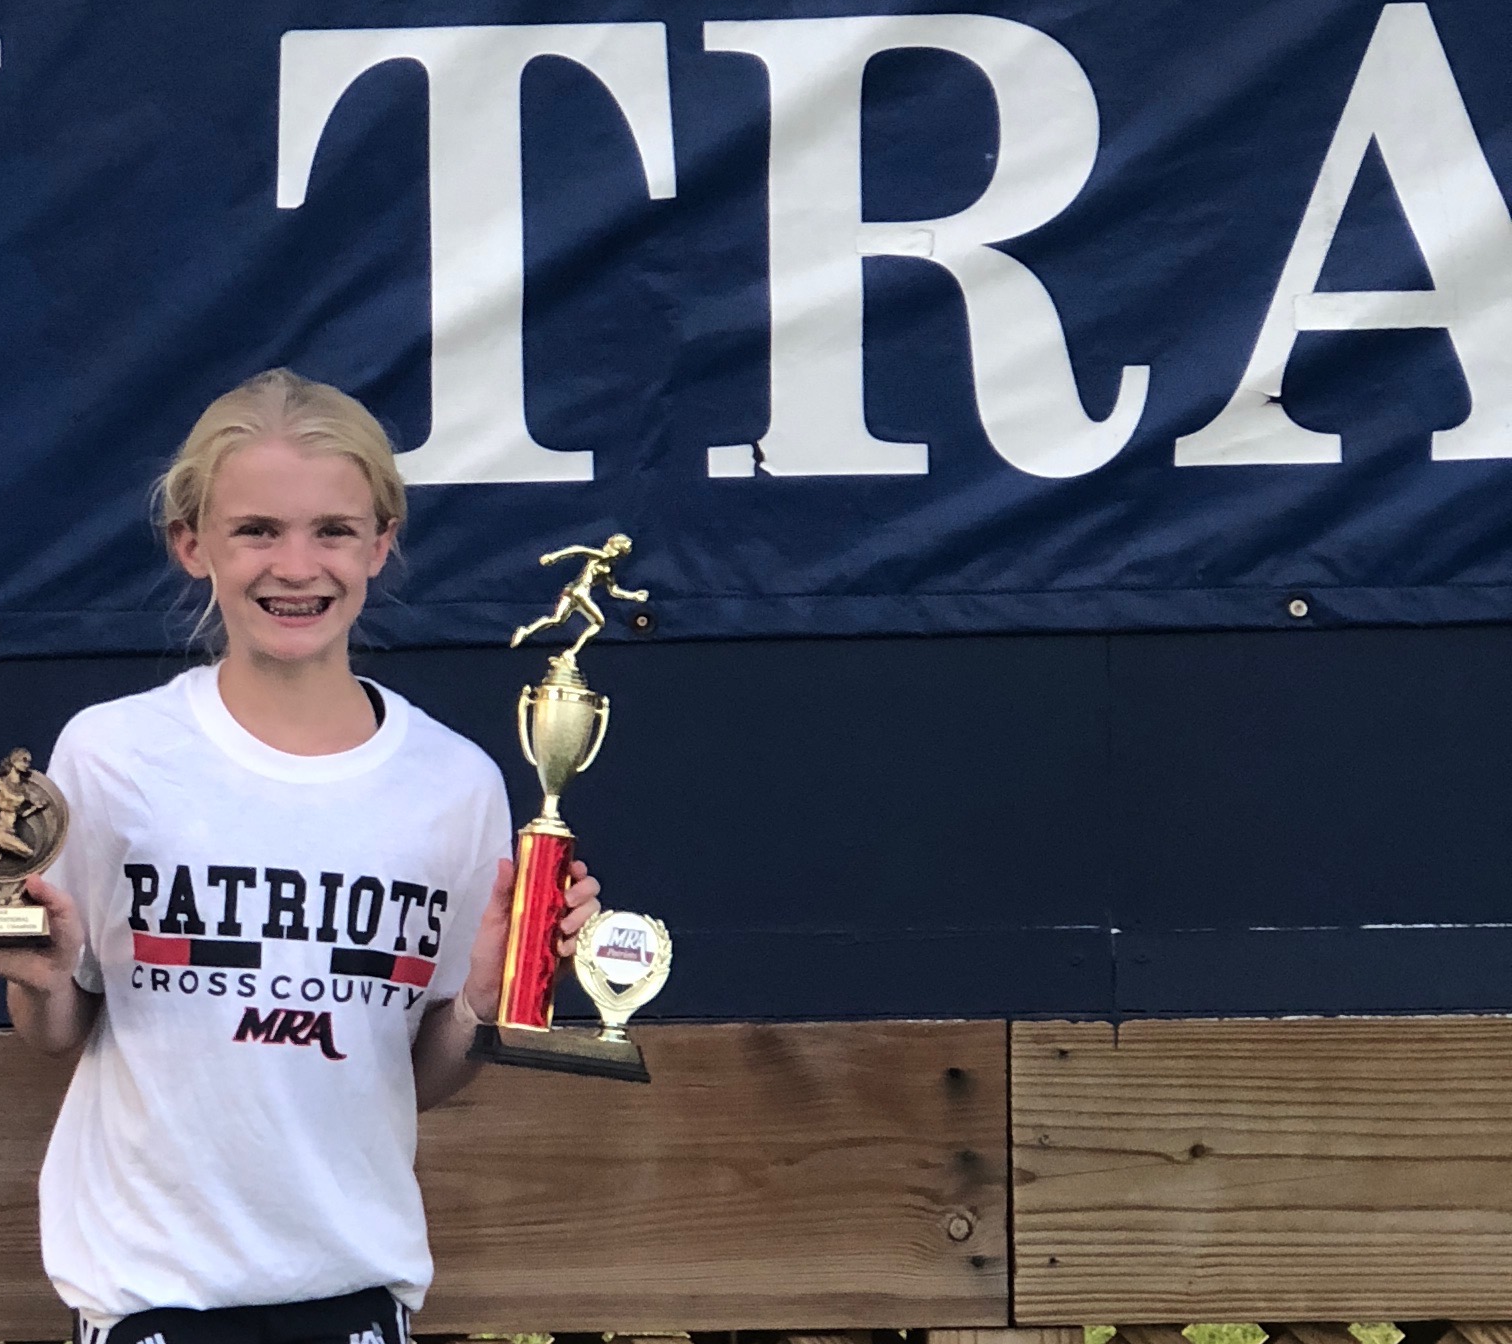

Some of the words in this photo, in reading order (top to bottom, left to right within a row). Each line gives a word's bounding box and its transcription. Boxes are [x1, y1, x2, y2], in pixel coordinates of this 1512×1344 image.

[124, 863, 447, 958] PATRIOTS
[606, 926, 650, 967] MRA
[232, 1006, 348, 1061] MRA
